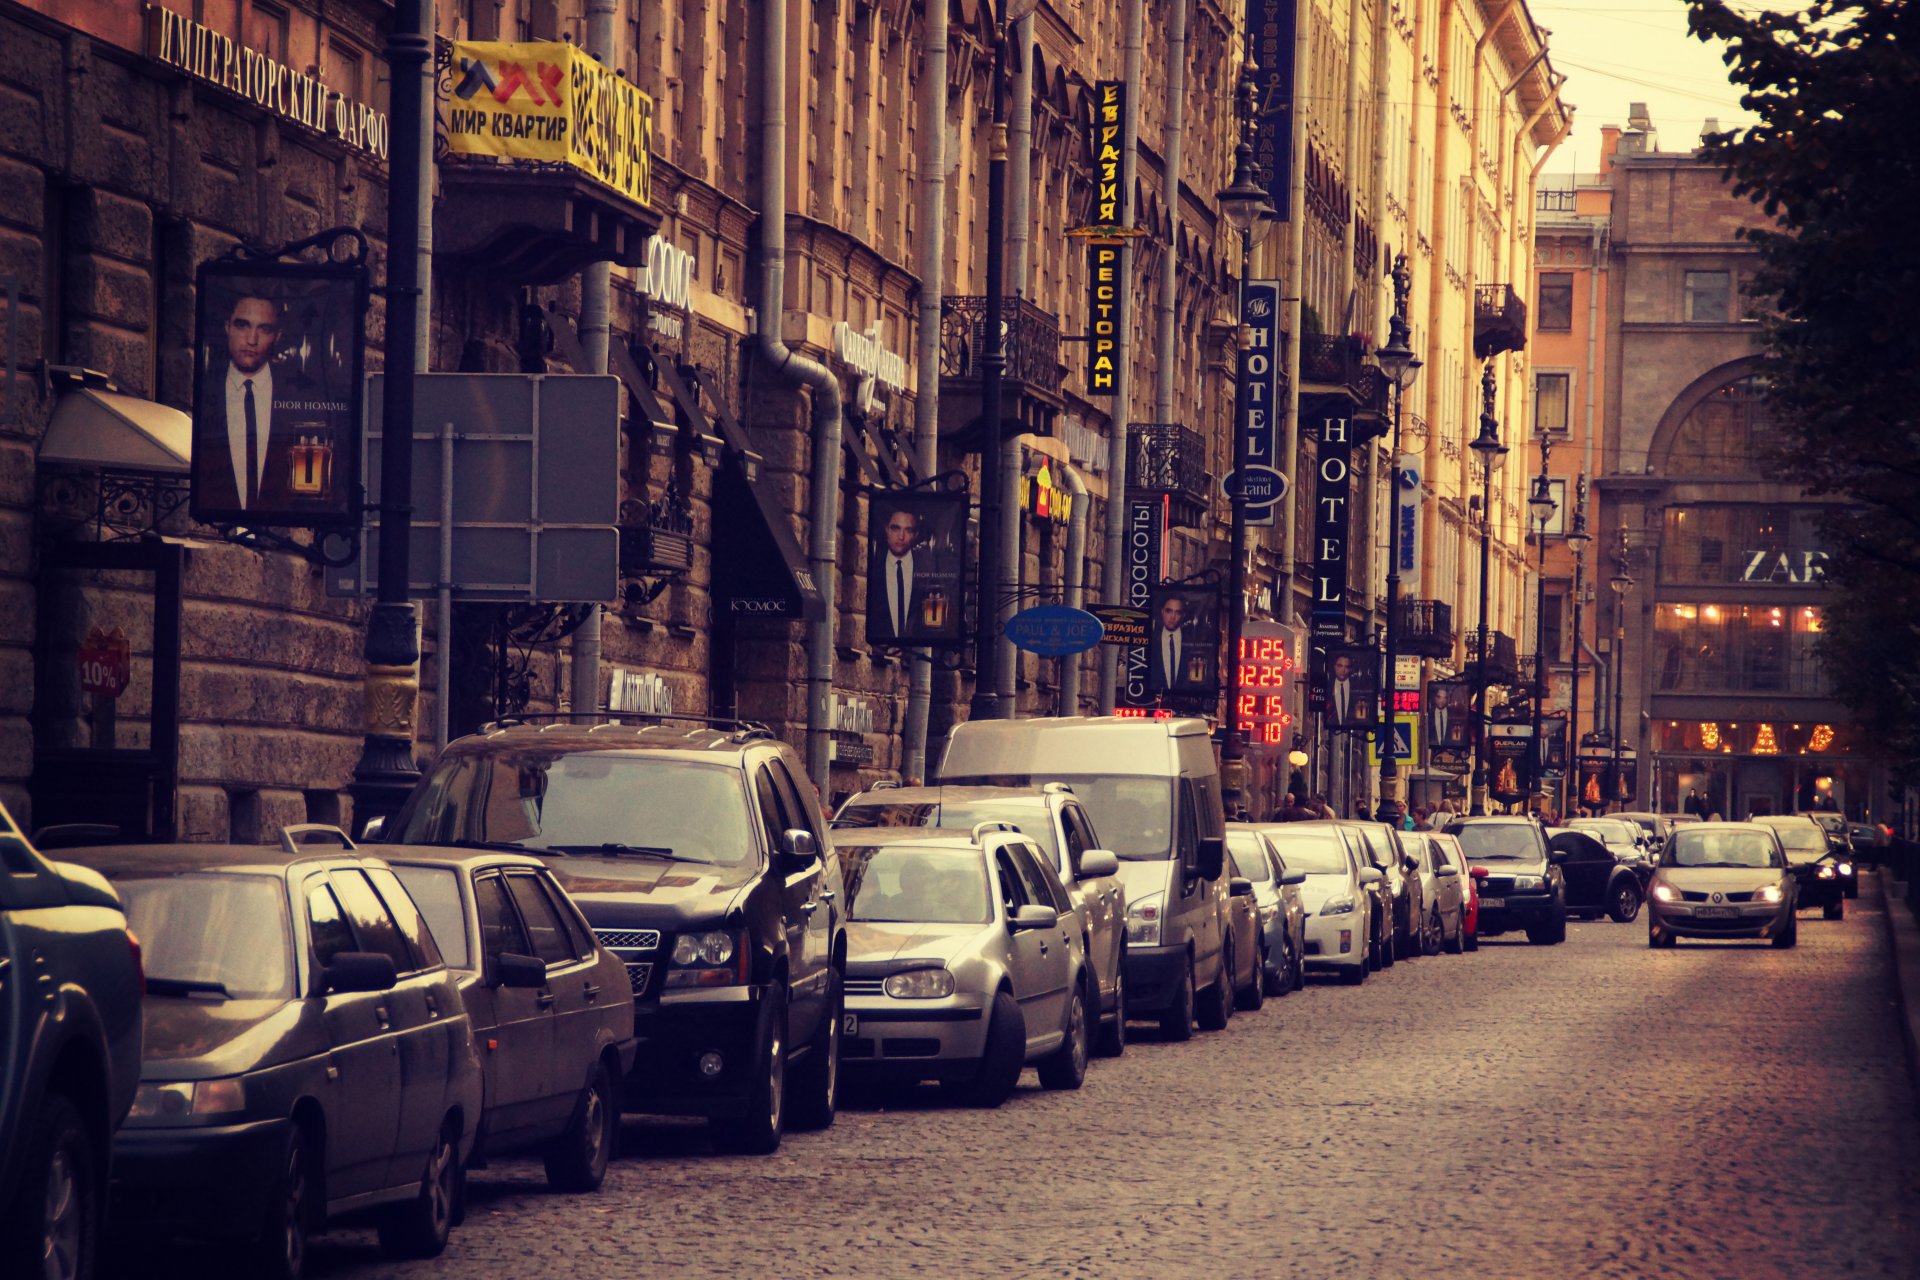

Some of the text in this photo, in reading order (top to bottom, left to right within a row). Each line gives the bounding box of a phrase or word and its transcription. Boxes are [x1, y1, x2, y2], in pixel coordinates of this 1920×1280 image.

[158, 7, 388, 160] ИМПЕРАТОРСКИЙ ФАРФО
[451, 109, 568, 142] МИР КВАРТИР
[1098, 85, 1120, 221] ЕВРАЗИЯ
[1094, 250, 1116, 388] РЕСТОРАН
[273, 400, 347, 411] DIOR HOMME
[1247, 326, 1270, 455] HOTEL
[1243, 483, 1271, 496] rand
[1319, 418, 1347, 602] HOTEL
[1740, 550, 1830, 582] ZAR
[730, 600, 786, 611] КОСМОС
[1015, 624, 1089, 637] PAUL & JOE
[82, 661, 116, 688] 10%
[846, 1016, 855, 1032] 2
